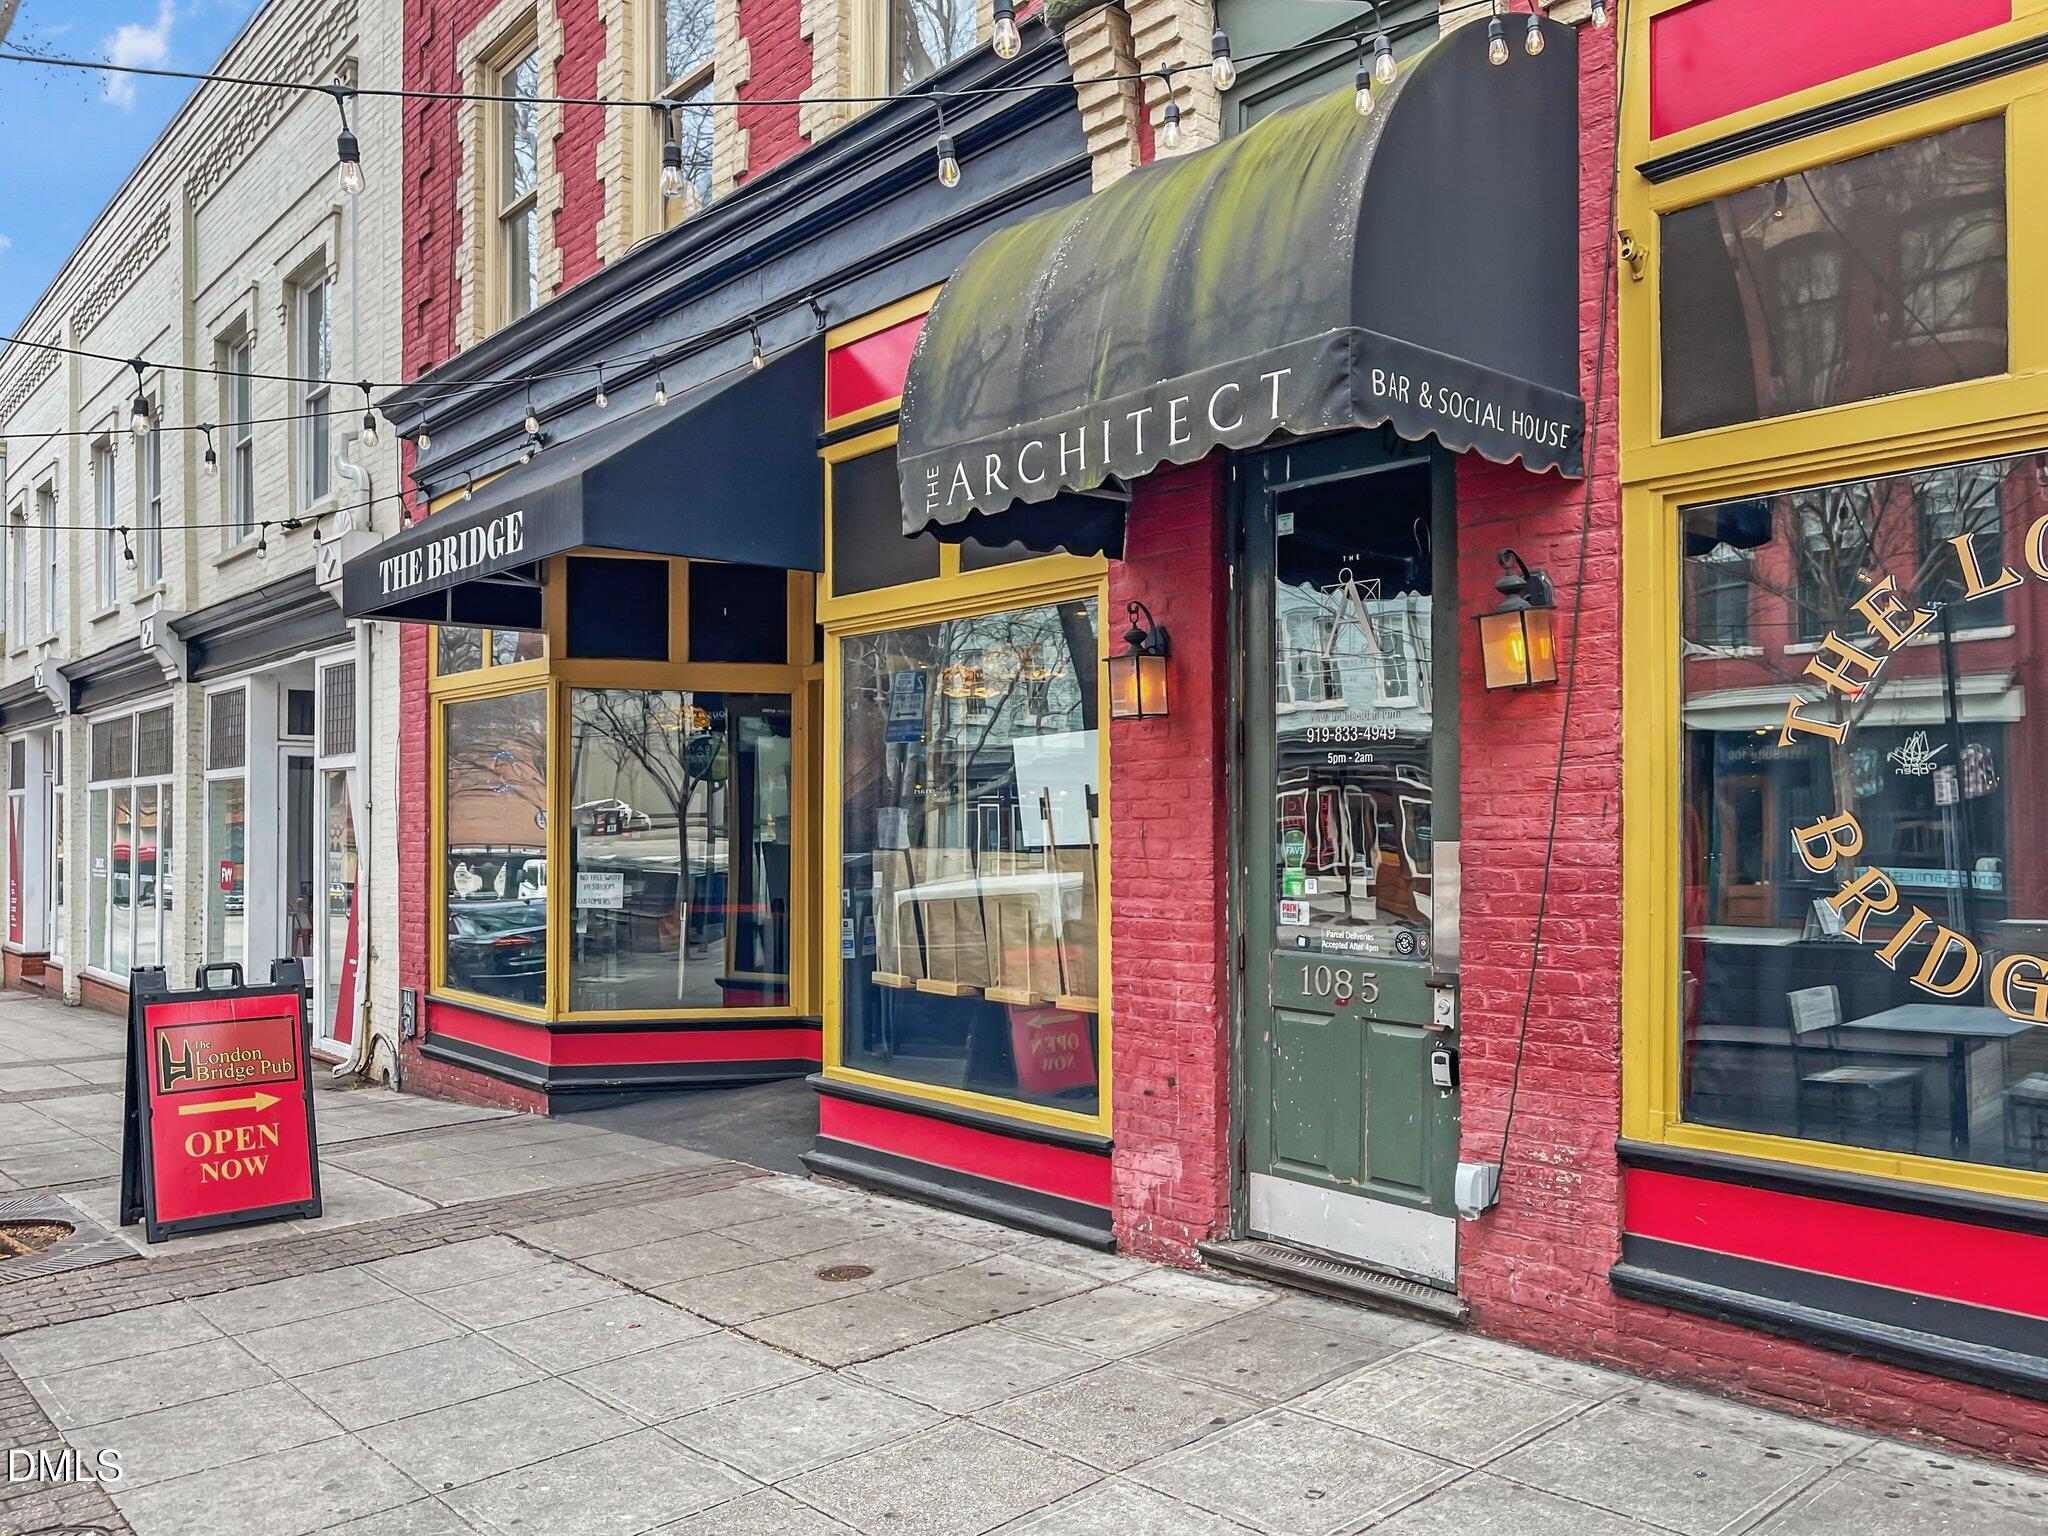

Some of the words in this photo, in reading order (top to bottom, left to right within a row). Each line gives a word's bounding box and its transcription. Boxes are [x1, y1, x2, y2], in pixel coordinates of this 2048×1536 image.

[1371, 367, 1411, 404] BAR
[1419, 381, 1434, 410] &
[1438, 387, 1506, 432] SOCIAL
[1511, 409, 1572, 449] HOUSE
[925, 464, 940, 514] THE
[945, 367, 1293, 506] ARCHITECT
[379, 547, 423, 595] THE
[426, 510, 524, 581] BRIDGE
[1342, 553, 1361, 562] THE
[1778, 574, 1938, 748] THE
[1306, 724, 1397, 743] 919-833-4949
[1327, 752, 1347, 764] 5pm
[1354, 752, 1374, 763] 2am
[1321, 940, 1349, 951] Accepted
[1349, 941, 1365, 951] After
[1364, 943, 1379, 953] 4pm
[1326, 929, 1345, 939] Parcel
[1345, 930, 1375, 941] Deliveries
[1300, 964, 1379, 1003] 1085
[194, 1041, 211, 1050] The
[195, 1046, 262, 1067] London
[196, 1064, 256, 1081] Bridge
[260, 1057, 292, 1076] Pub
[184, 1122, 281, 1158] OPEN
[200, 1154, 270, 1184] NOW
